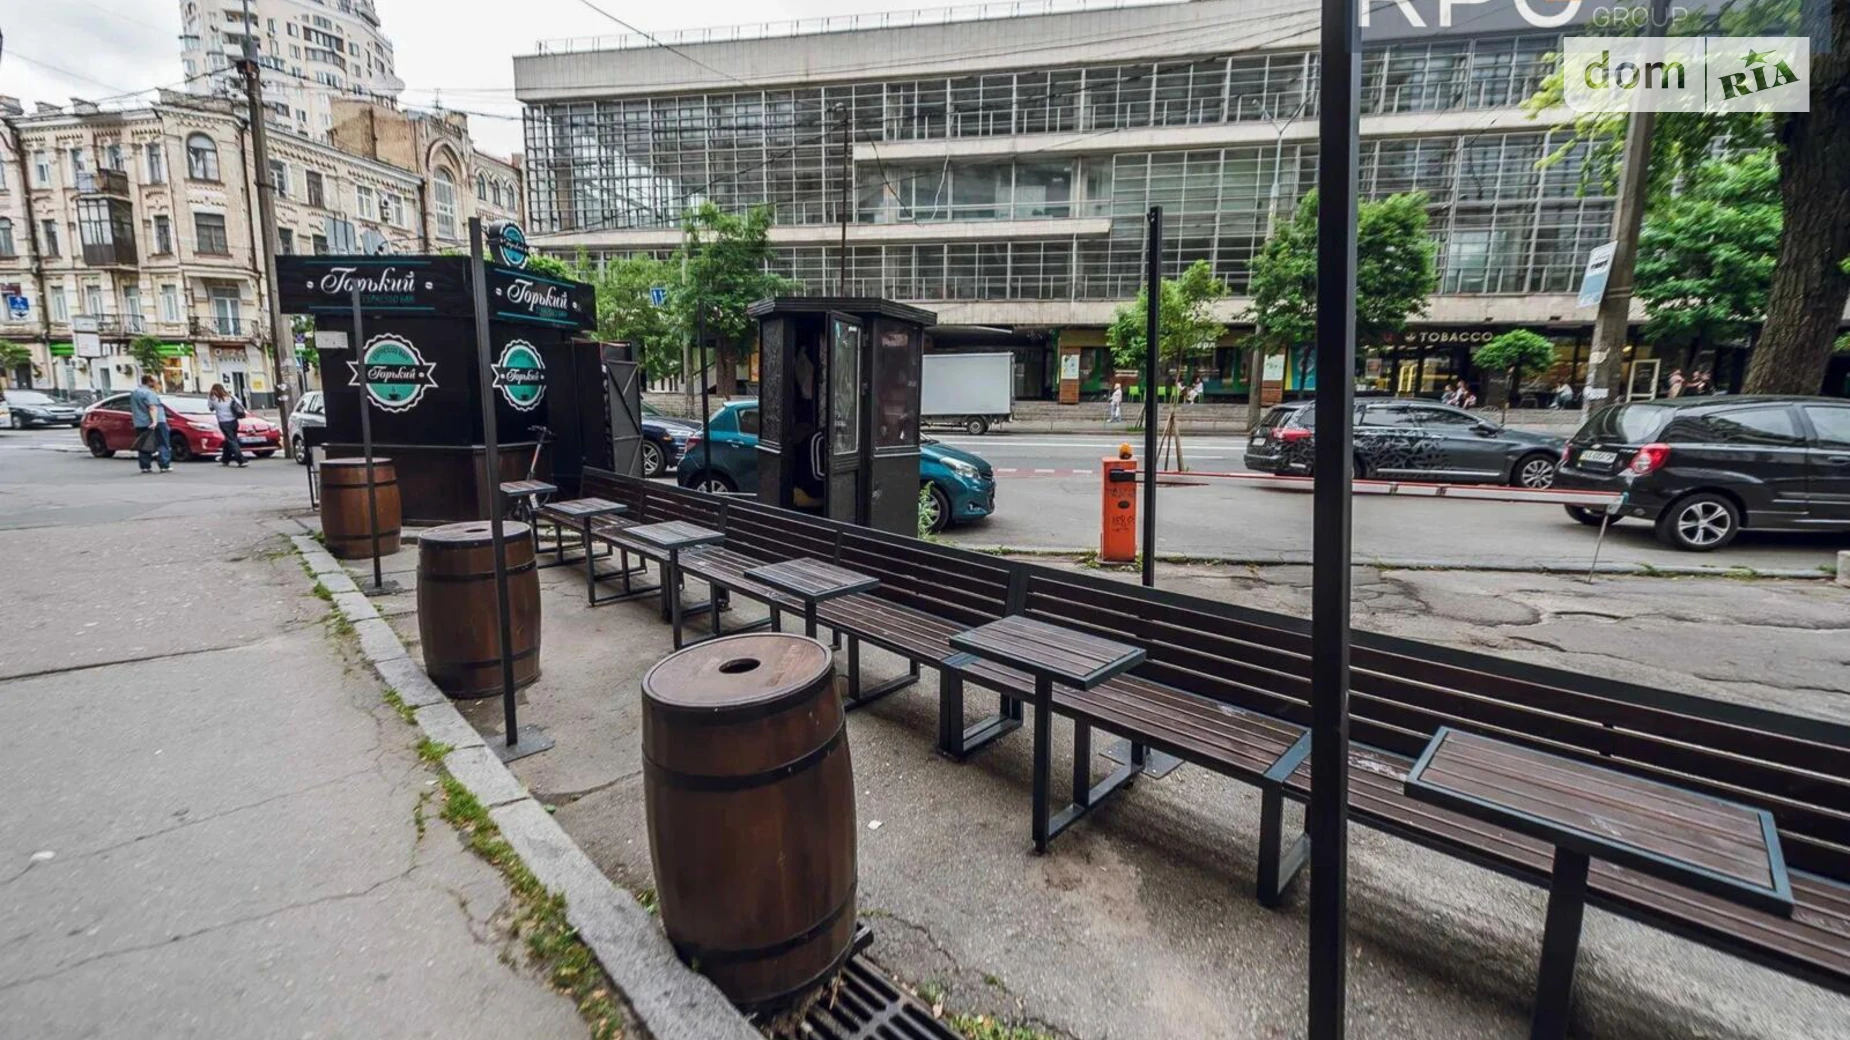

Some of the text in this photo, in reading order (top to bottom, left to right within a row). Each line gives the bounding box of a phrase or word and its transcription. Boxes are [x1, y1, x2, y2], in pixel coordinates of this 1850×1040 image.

[507, 278, 568, 312] Горький
[1419, 331, 1493, 343] TOBACCO
[367, 365, 416, 383] Горький
